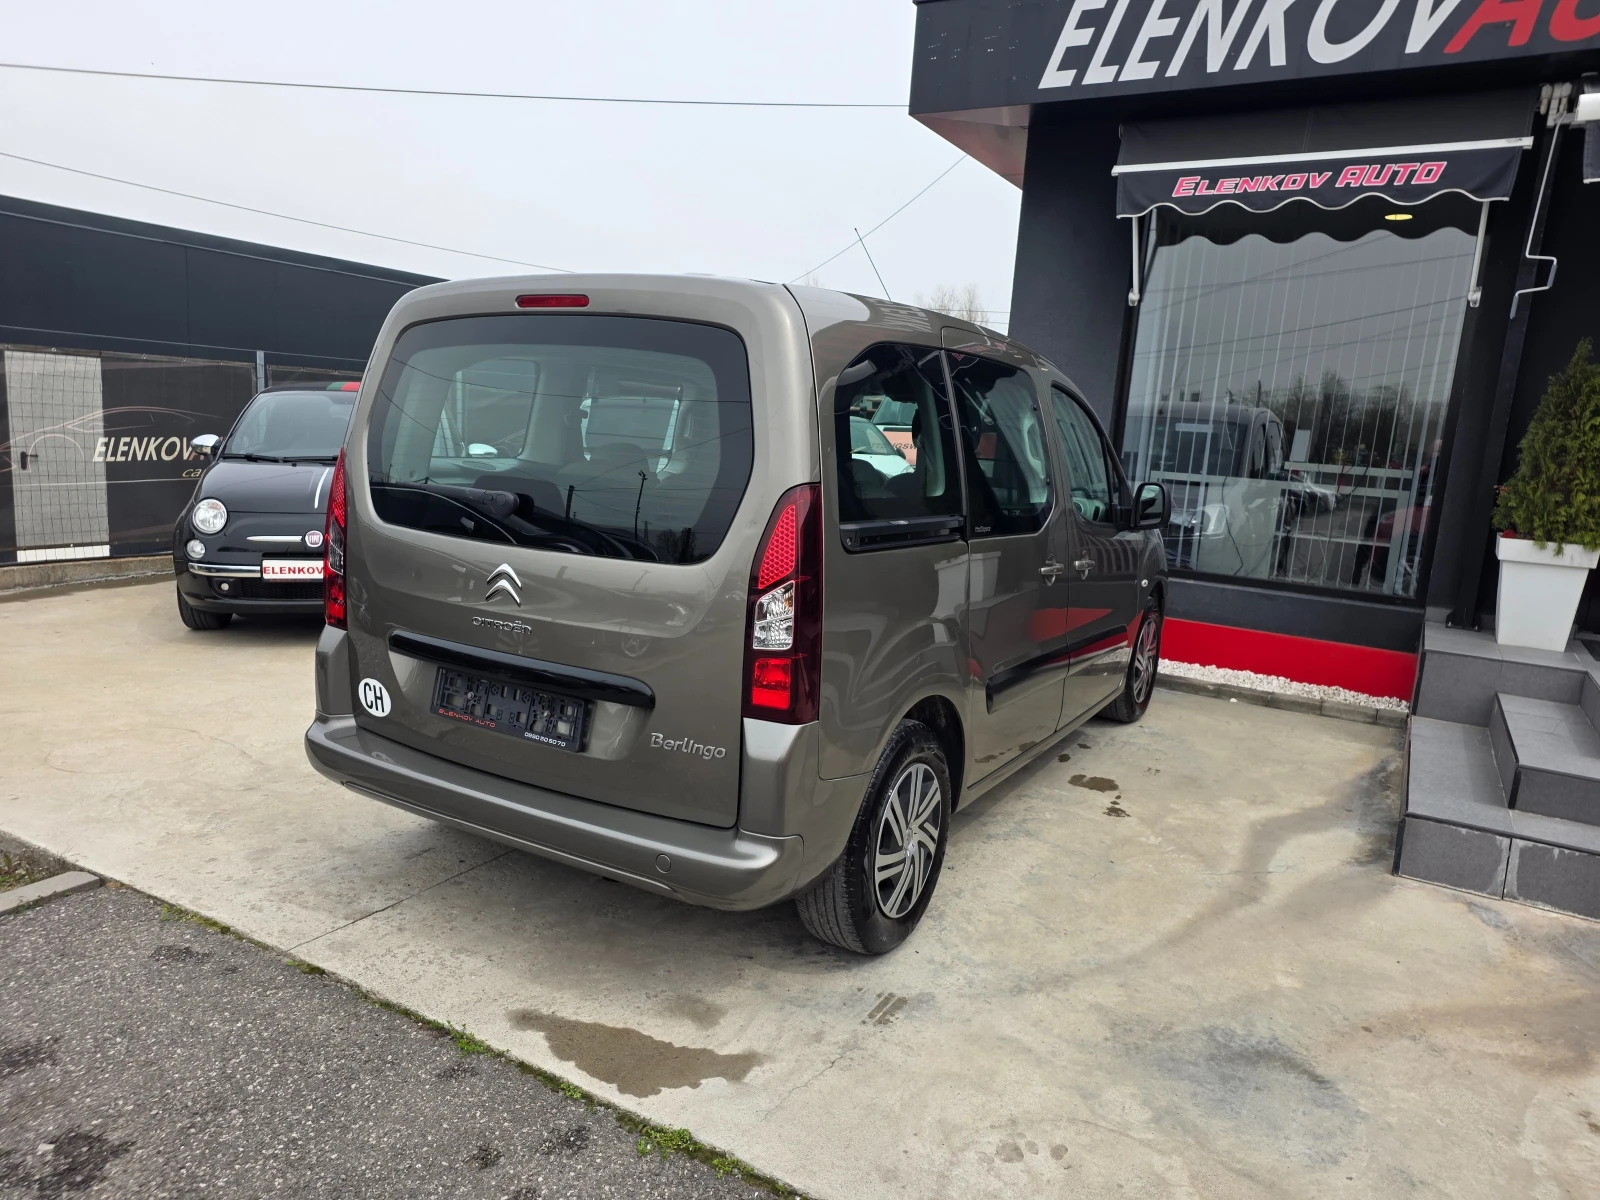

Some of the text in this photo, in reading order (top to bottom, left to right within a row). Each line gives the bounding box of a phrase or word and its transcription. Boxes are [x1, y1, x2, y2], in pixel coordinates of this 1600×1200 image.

[1172, 161, 1447, 197] ELENKOV AUTO
[263, 566, 324, 575] ELENKOV
[363, 681, 385, 713] CH
[438, 708, 497, 728] ELENKOV AUTO
[650, 732, 727, 760] Berlingo
